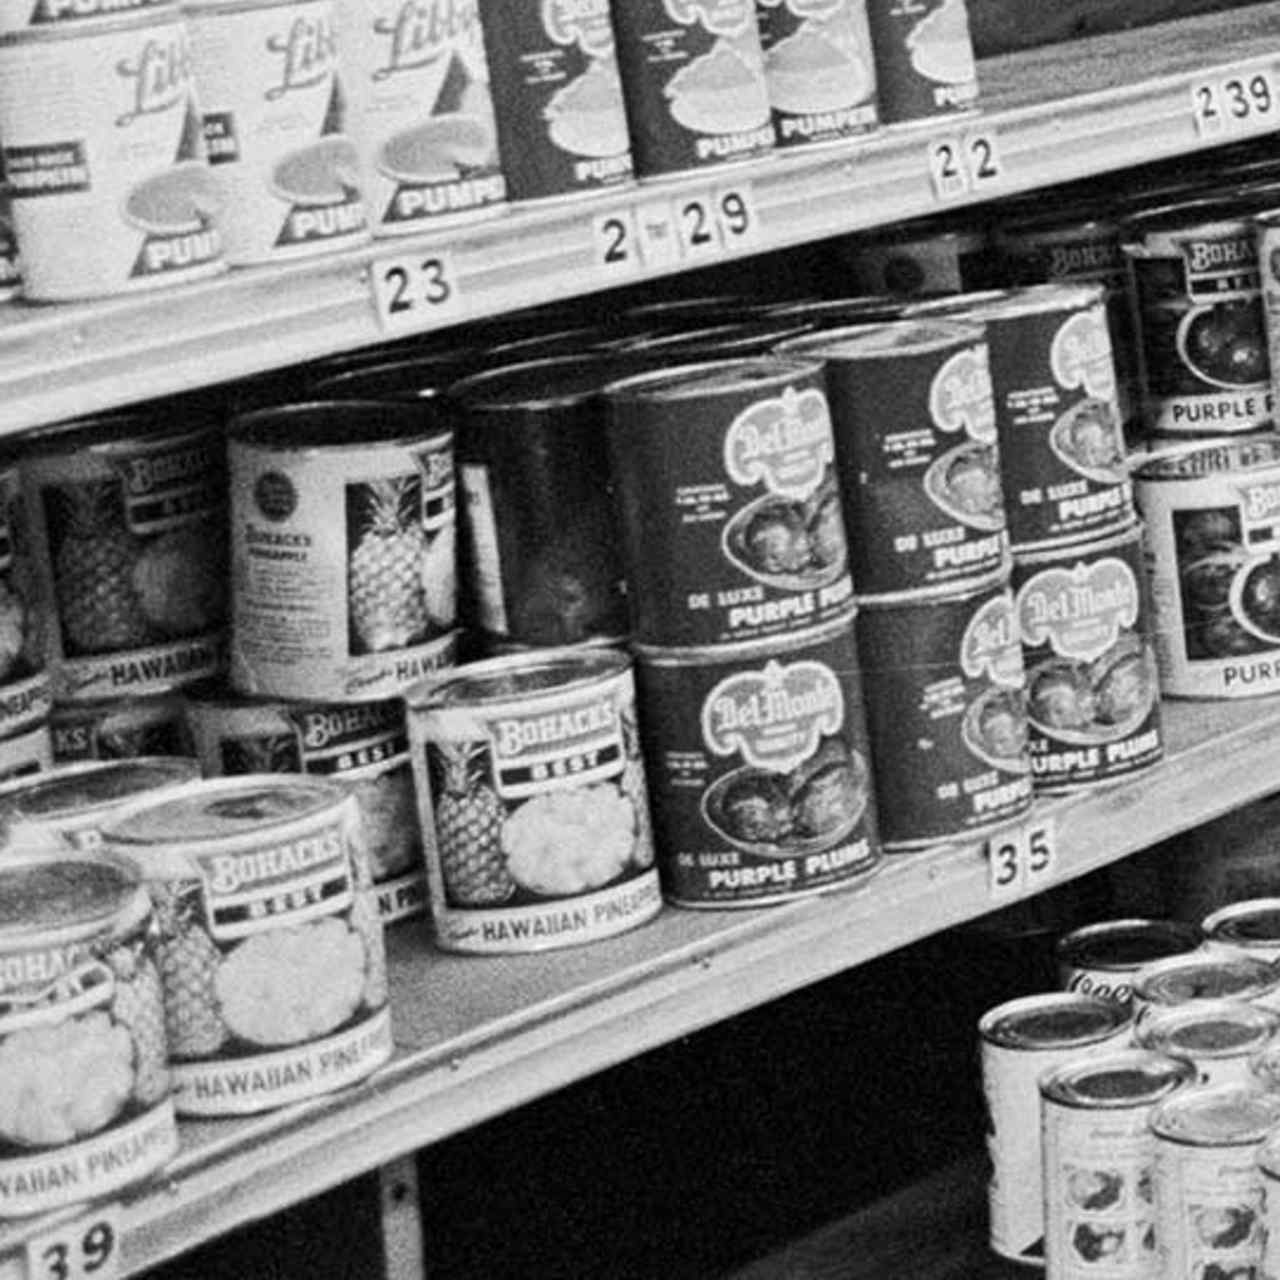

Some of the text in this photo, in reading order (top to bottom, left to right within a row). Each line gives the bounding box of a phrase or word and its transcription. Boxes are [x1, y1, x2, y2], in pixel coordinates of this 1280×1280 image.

[935, 139, 997, 183] 22
[682, 192, 748, 244] 29
[384, 259, 451, 314] 23
[1172, 399, 1257, 423] PURPLE
[688, 584, 765, 610] DE LUXE
[729, 594, 816, 629] PURPLE
[529, 752, 601, 781] BEST
[709, 839, 871, 891] PURPLE PLUMS
[995, 829, 1052, 886] 35
[481, 912, 588, 943] HAWAIIAN
[194, 1061, 312, 1099] HAWAIIAN
